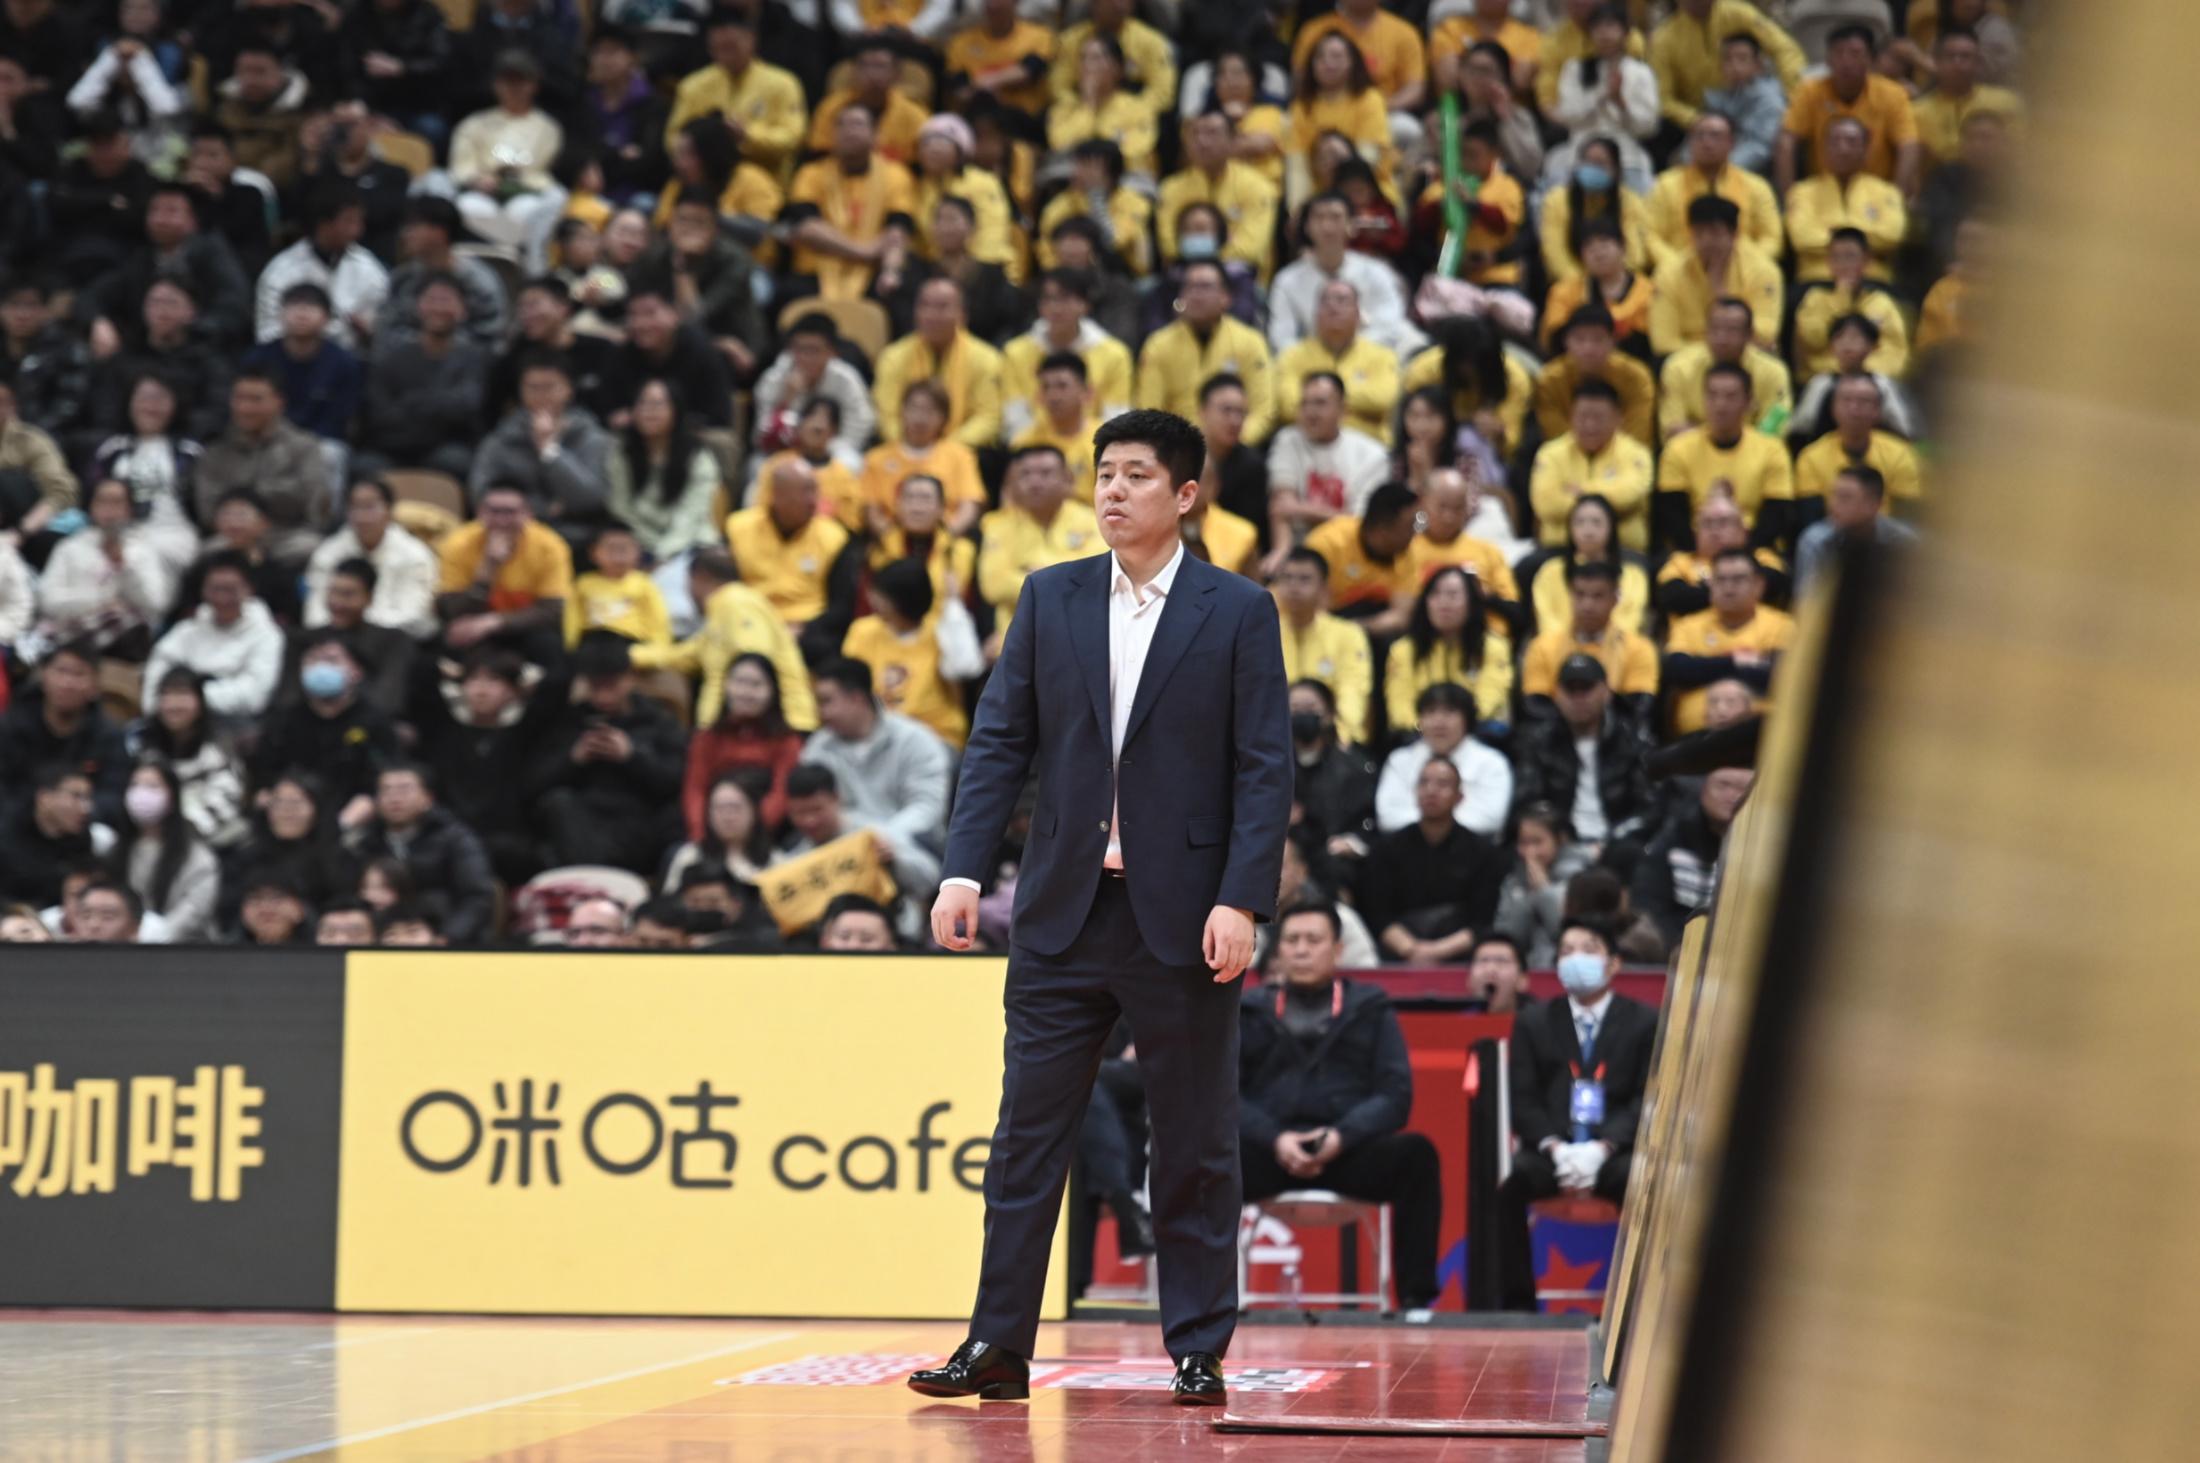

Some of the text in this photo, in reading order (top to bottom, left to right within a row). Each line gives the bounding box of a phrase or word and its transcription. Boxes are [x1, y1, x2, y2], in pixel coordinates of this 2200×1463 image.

[0, 1064, 264, 1200] 咖啡
[400, 1079, 992, 1193] 咪咕 cafe
